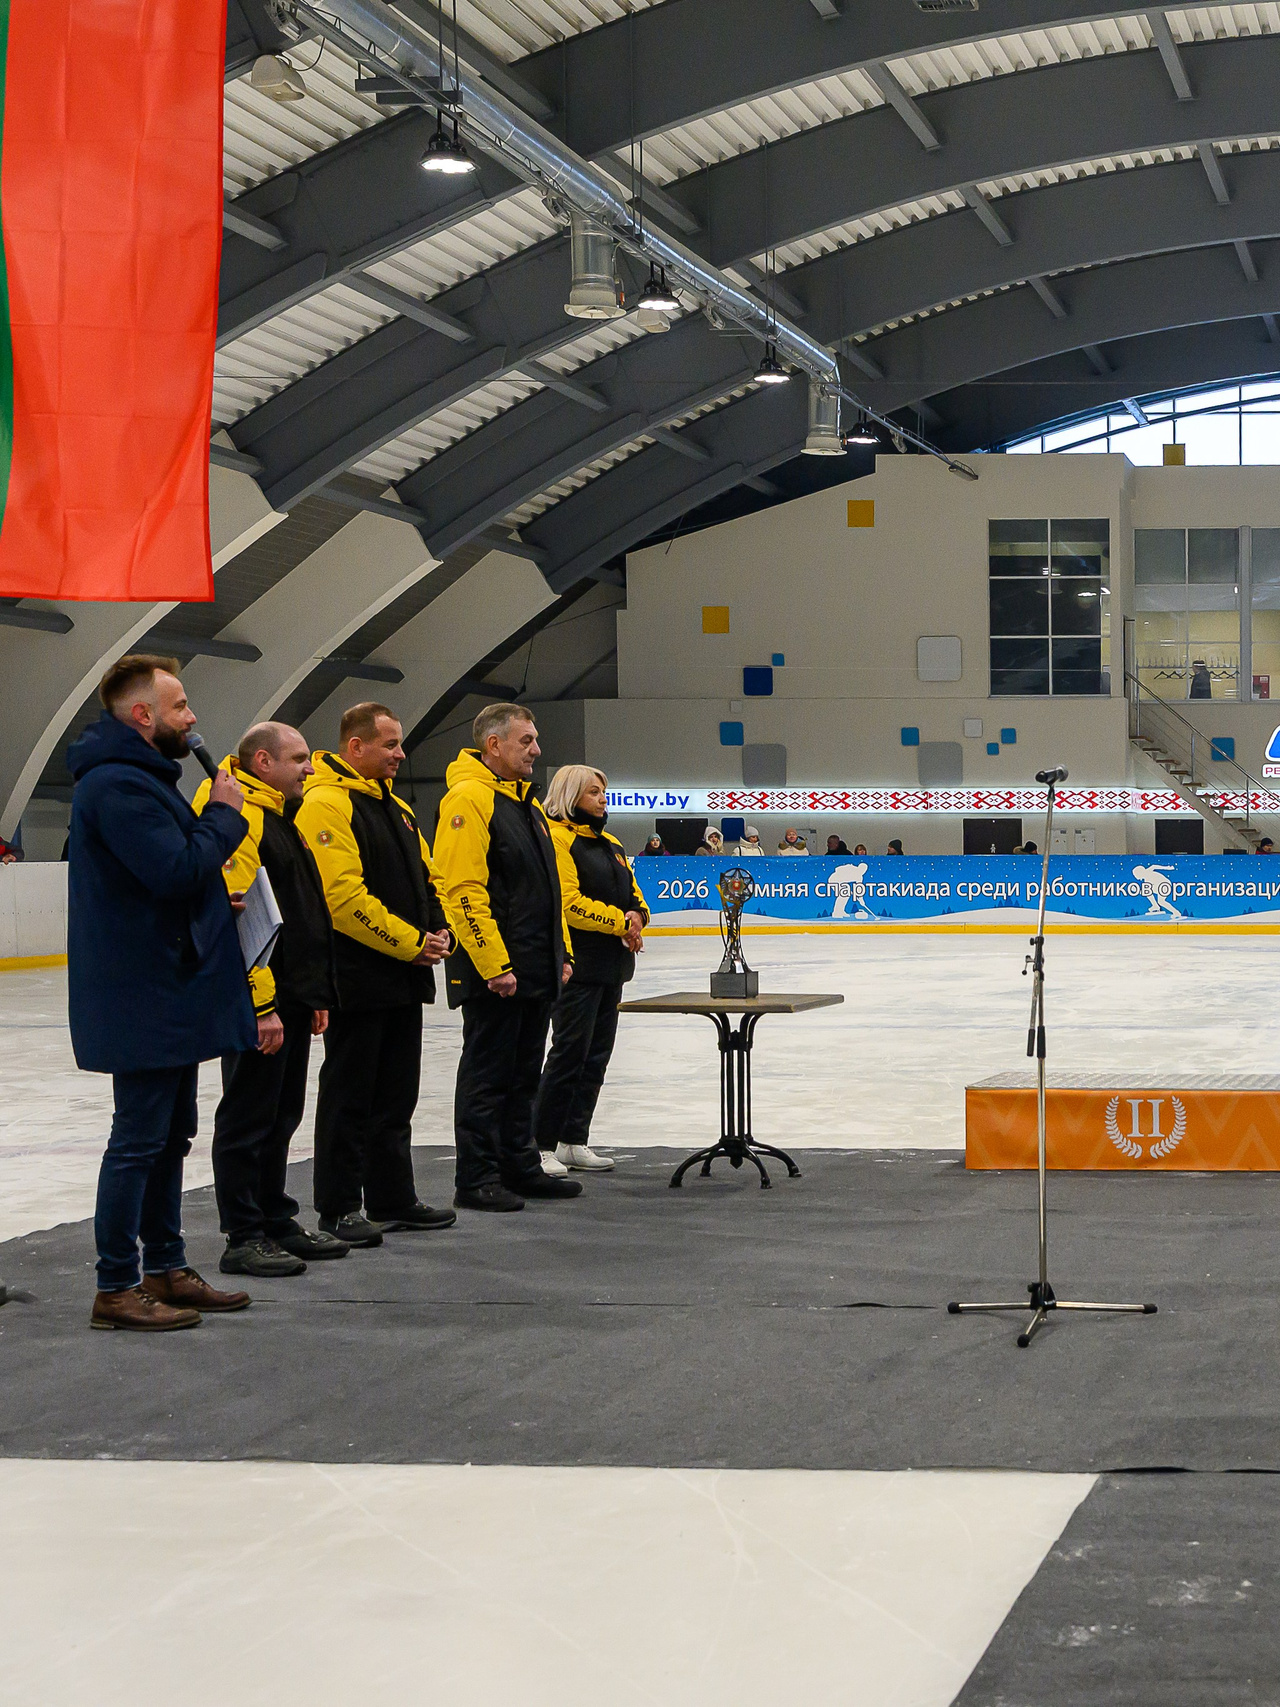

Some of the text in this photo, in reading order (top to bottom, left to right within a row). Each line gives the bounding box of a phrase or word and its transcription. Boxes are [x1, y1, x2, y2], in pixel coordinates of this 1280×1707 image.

[606, 792, 690, 809] ilichy.by
[657, 879, 709, 899] 2026
[747, 883, 809, 898] мняя
[814, 882, 951, 902] спартакиада
[955, 882, 1020, 902] среди
[352, 909, 401, 948] BELARUS
[459, 895, 487, 949] BELARUS
[569, 904, 616, 927] BELARUS
[1126, 1098, 1165, 1138] II
